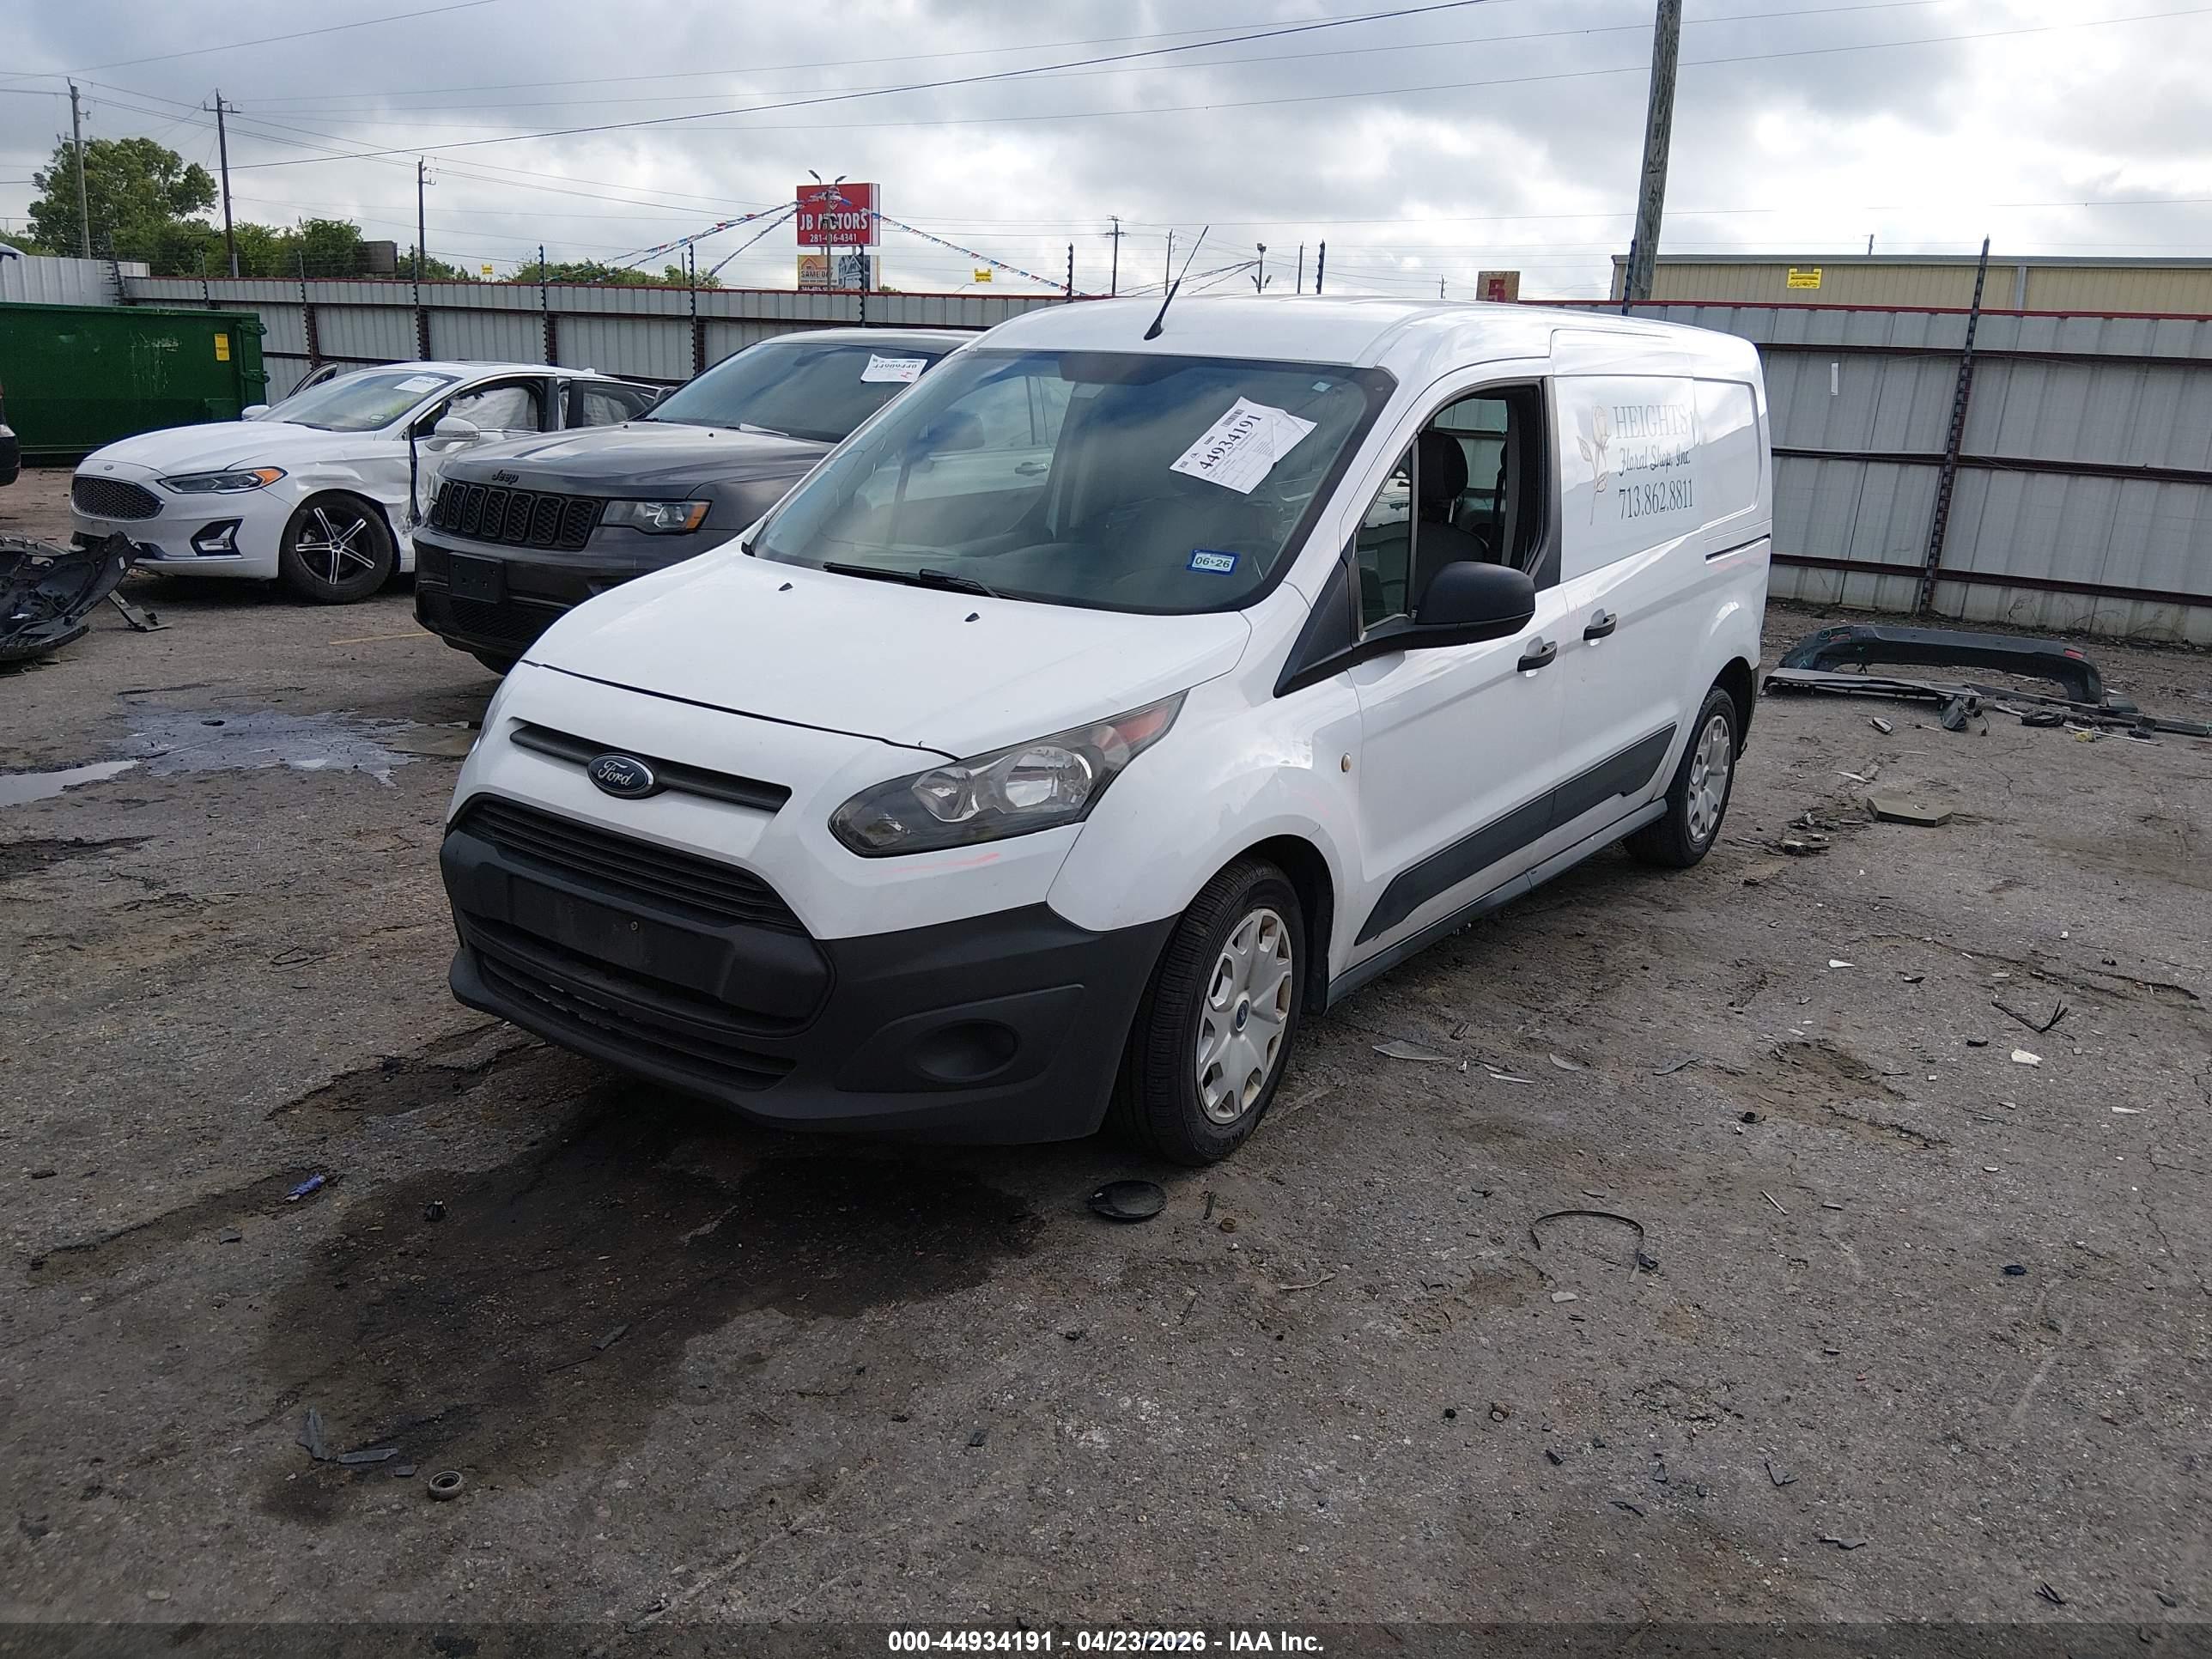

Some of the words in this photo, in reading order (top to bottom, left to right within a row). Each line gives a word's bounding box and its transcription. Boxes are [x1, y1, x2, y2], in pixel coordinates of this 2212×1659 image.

[799, 213, 814, 231] JB
[1612, 404, 1689, 440] HEIGHTS
[1199, 414, 1262, 470] 44934191
[1619, 447, 1648, 477] Floral
[491, 469, 520, 485] Jeep
[1619, 477, 1693, 520] 713.862.8811
[1194, 556, 1210, 566] 06
[1215, 558, 1231, 568] 26
[598, 760, 635, 787] Ford
